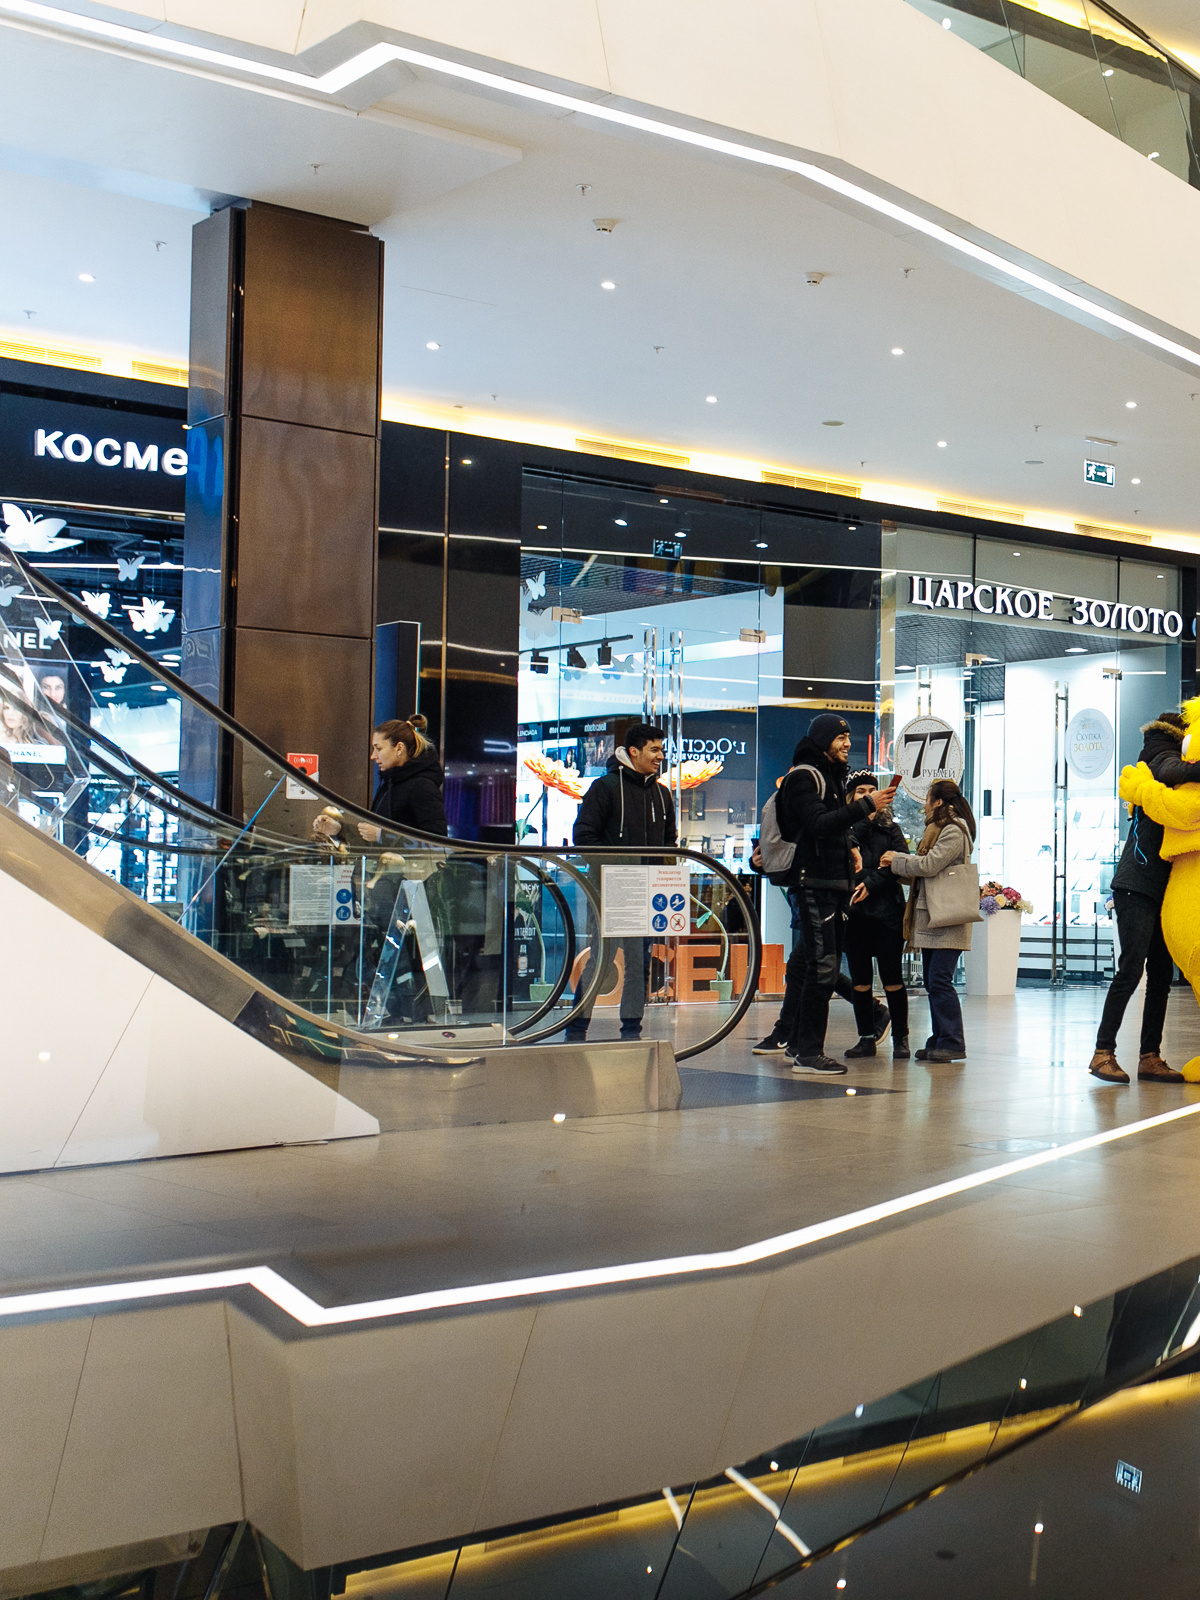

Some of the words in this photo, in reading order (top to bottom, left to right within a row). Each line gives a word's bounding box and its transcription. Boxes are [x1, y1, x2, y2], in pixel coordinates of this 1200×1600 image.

[909, 575, 1054, 621] ЦАРСКОЕ
[1071, 597, 1183, 638] ЗОЛОТО
[904, 731, 954, 779] 77
[1074, 742, 1104, 752] ЗОЛОТА
[922, 767, 955, 778] РУБЛЕЙ
